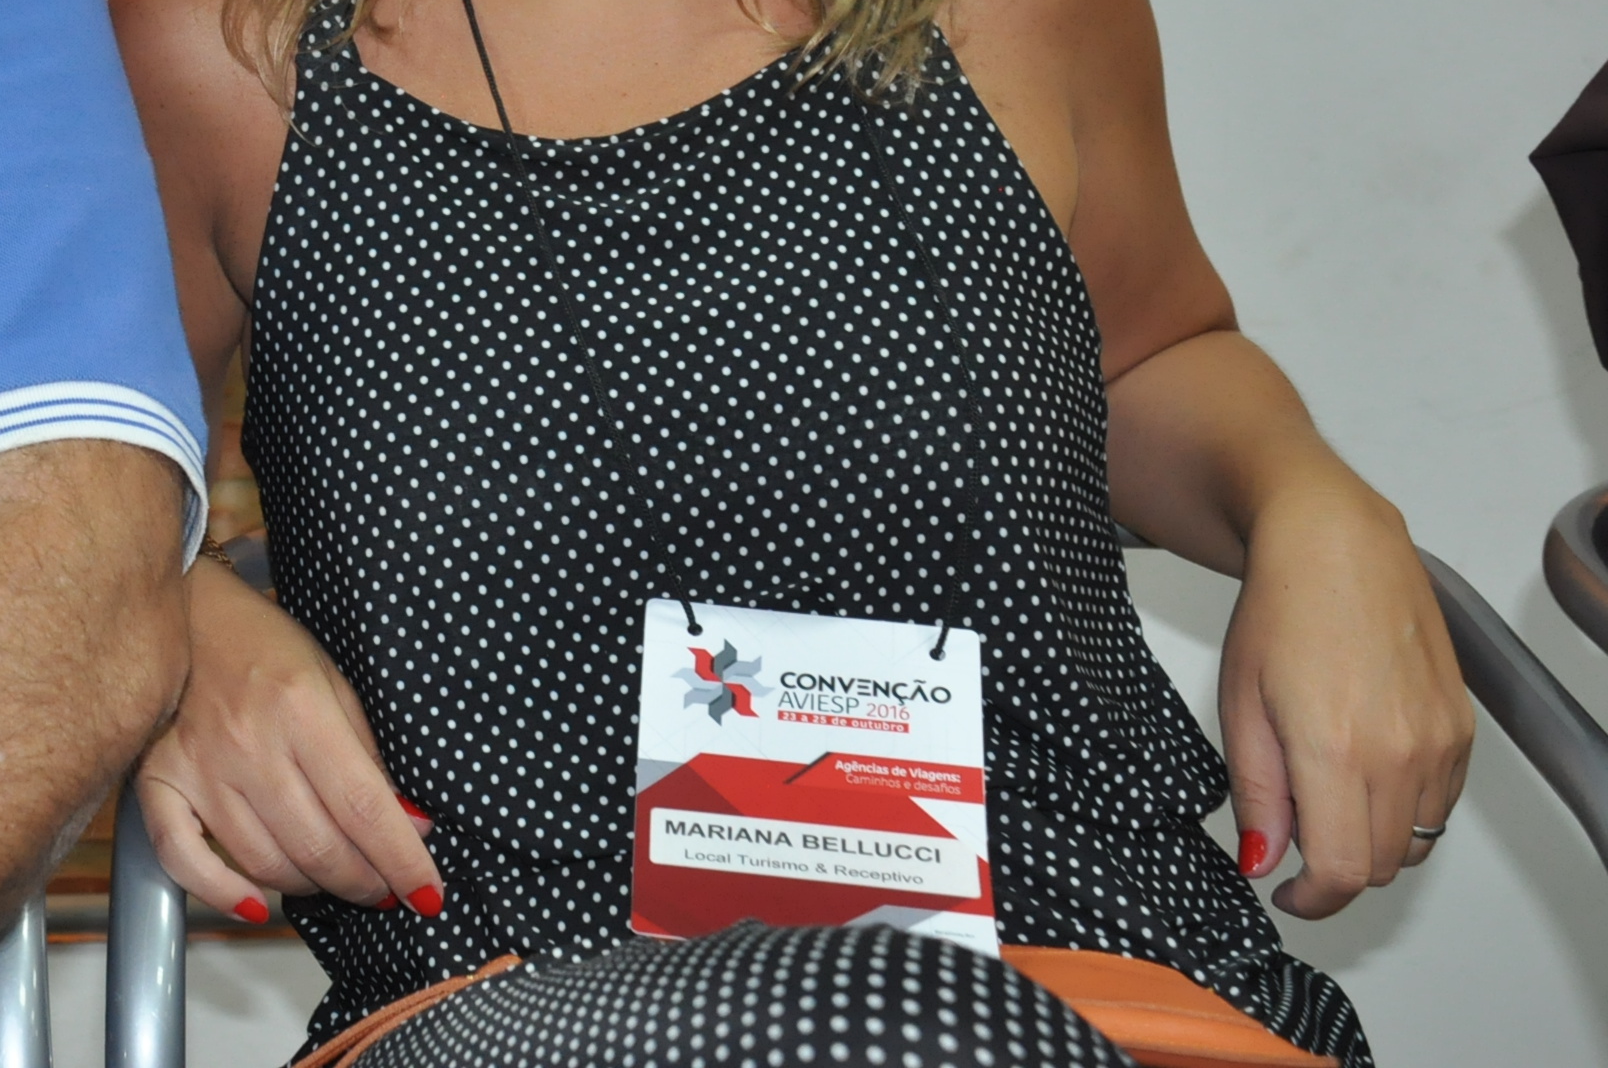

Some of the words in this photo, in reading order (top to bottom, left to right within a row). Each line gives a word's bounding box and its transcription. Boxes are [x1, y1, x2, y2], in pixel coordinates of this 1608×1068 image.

[780, 671, 952, 706] CONVENÇÃO
[778, 691, 860, 714] AVIESP
[866, 703, 910, 720] 2016
[782, 711, 797, 721] 23
[801, 714, 809, 723] a
[812, 715, 827, 725] 25
[831, 716, 847, 727] de
[851, 719, 904, 733] outubro
[835, 759, 889, 775] Agências
[891, 765, 907, 777] de
[909, 767, 961, 783] Viagens:
[846, 774, 901, 789] Caminhos
[903, 780, 911, 789] e
[914, 781, 961, 795] desafios
[665, 819, 793, 848] MARIANA
[802, 834, 941, 864] BELLUCCI
[684, 849, 731, 864] Local
[738, 854, 809, 872] Turismo
[815, 863, 827, 874] &
[834, 864, 924, 885] Receptivo
